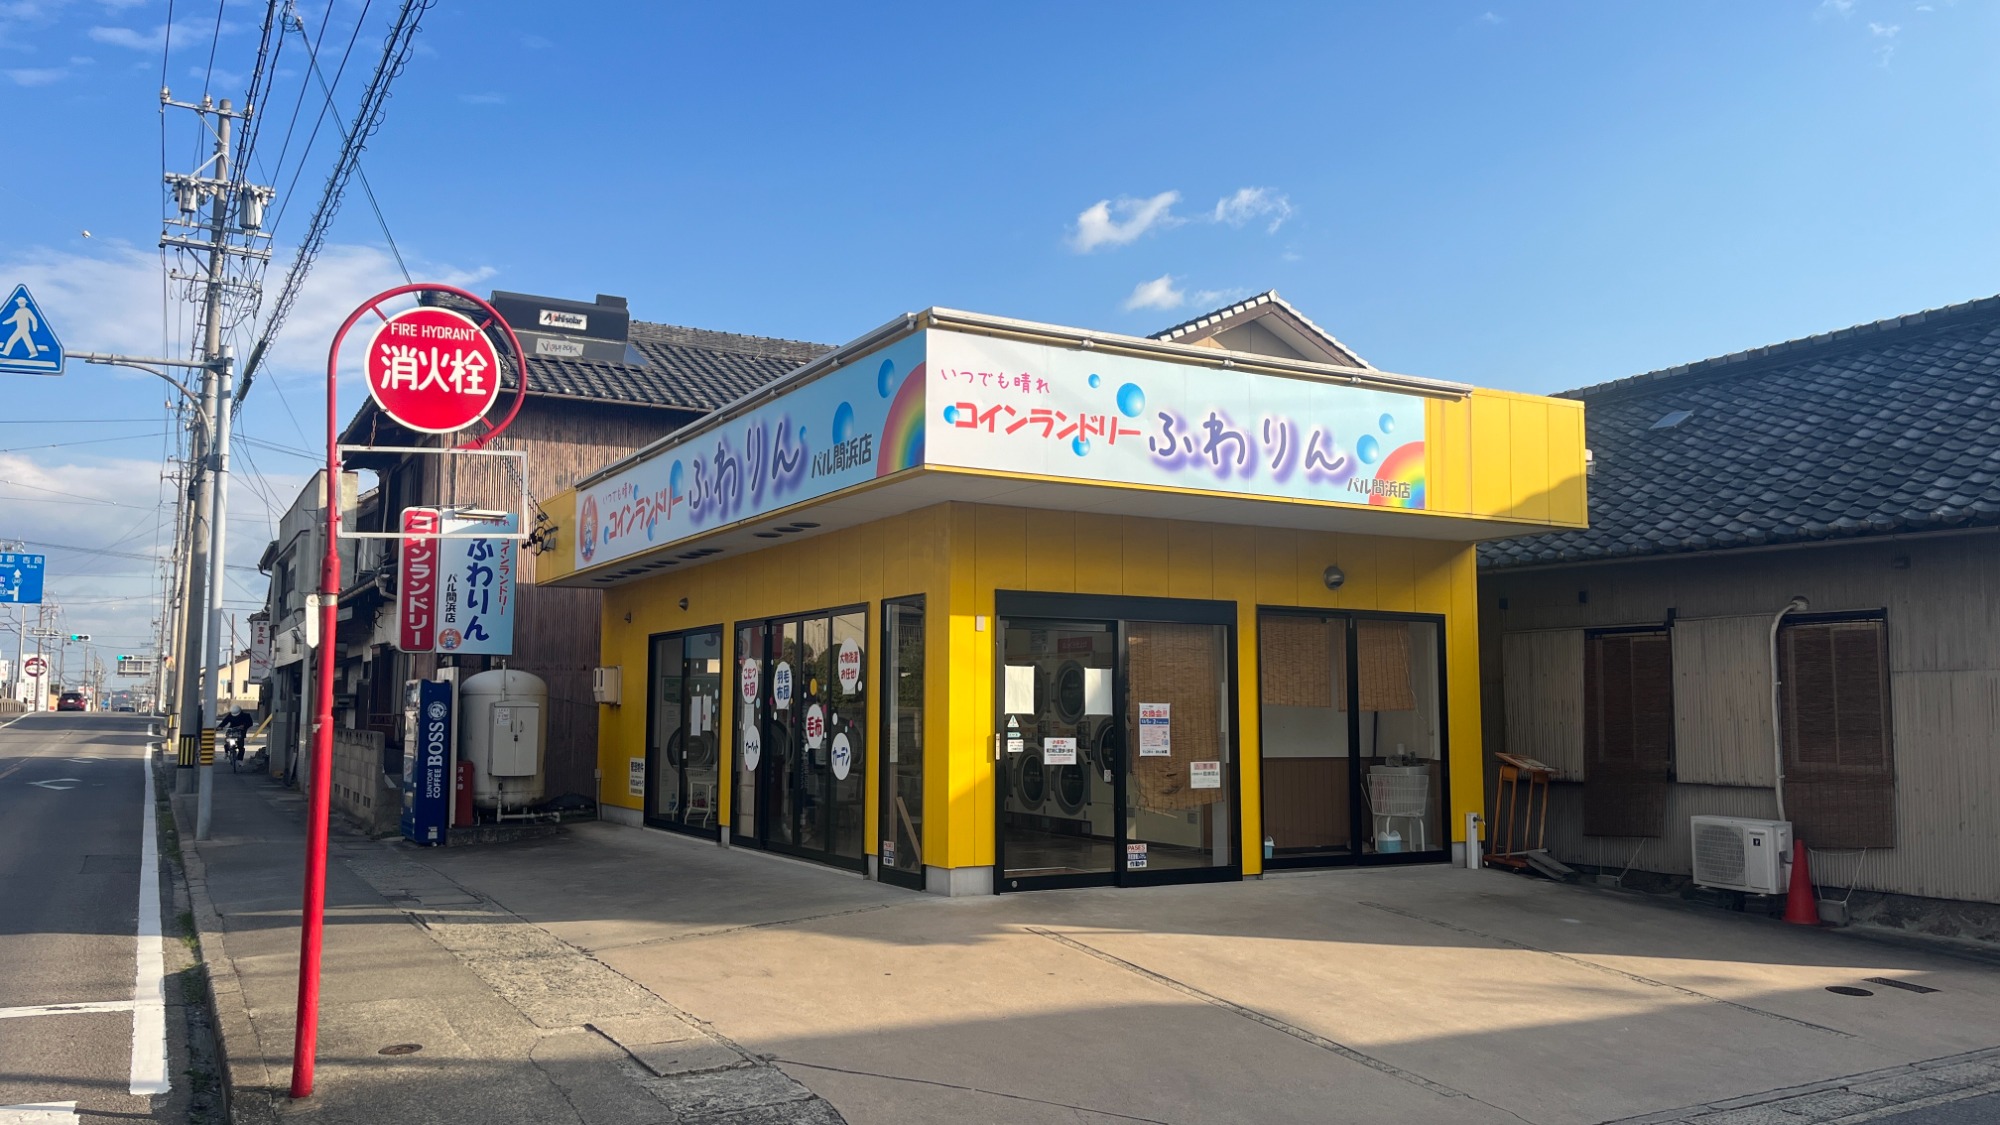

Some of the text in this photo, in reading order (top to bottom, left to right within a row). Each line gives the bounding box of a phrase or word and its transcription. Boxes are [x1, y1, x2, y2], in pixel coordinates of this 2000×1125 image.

[391, 322, 476, 341] FIRE HYDRANT
[380, 343, 488, 395] 消火栓
[940, 367, 1051, 394] いつでも晴れ
[954, 401, 1412, 500] コインランドリー ふわりん パル間浜店
[609, 421, 872, 539] コインランドリー ふわりん パル間浜店
[408, 515, 433, 646] コインランドリー
[463, 538, 494, 641] ふわりん
[444, 573, 458, 624] パル間浜店
[743, 681, 756, 697] 布団
[777, 669, 790, 683] 羽毛
[776, 685, 790, 700] 布団
[807, 716, 823, 738] 毛布
[427, 721, 445, 766] BOSS
[426, 768, 434, 798] SUNTORY
[433, 768, 442, 798] COFFEE
